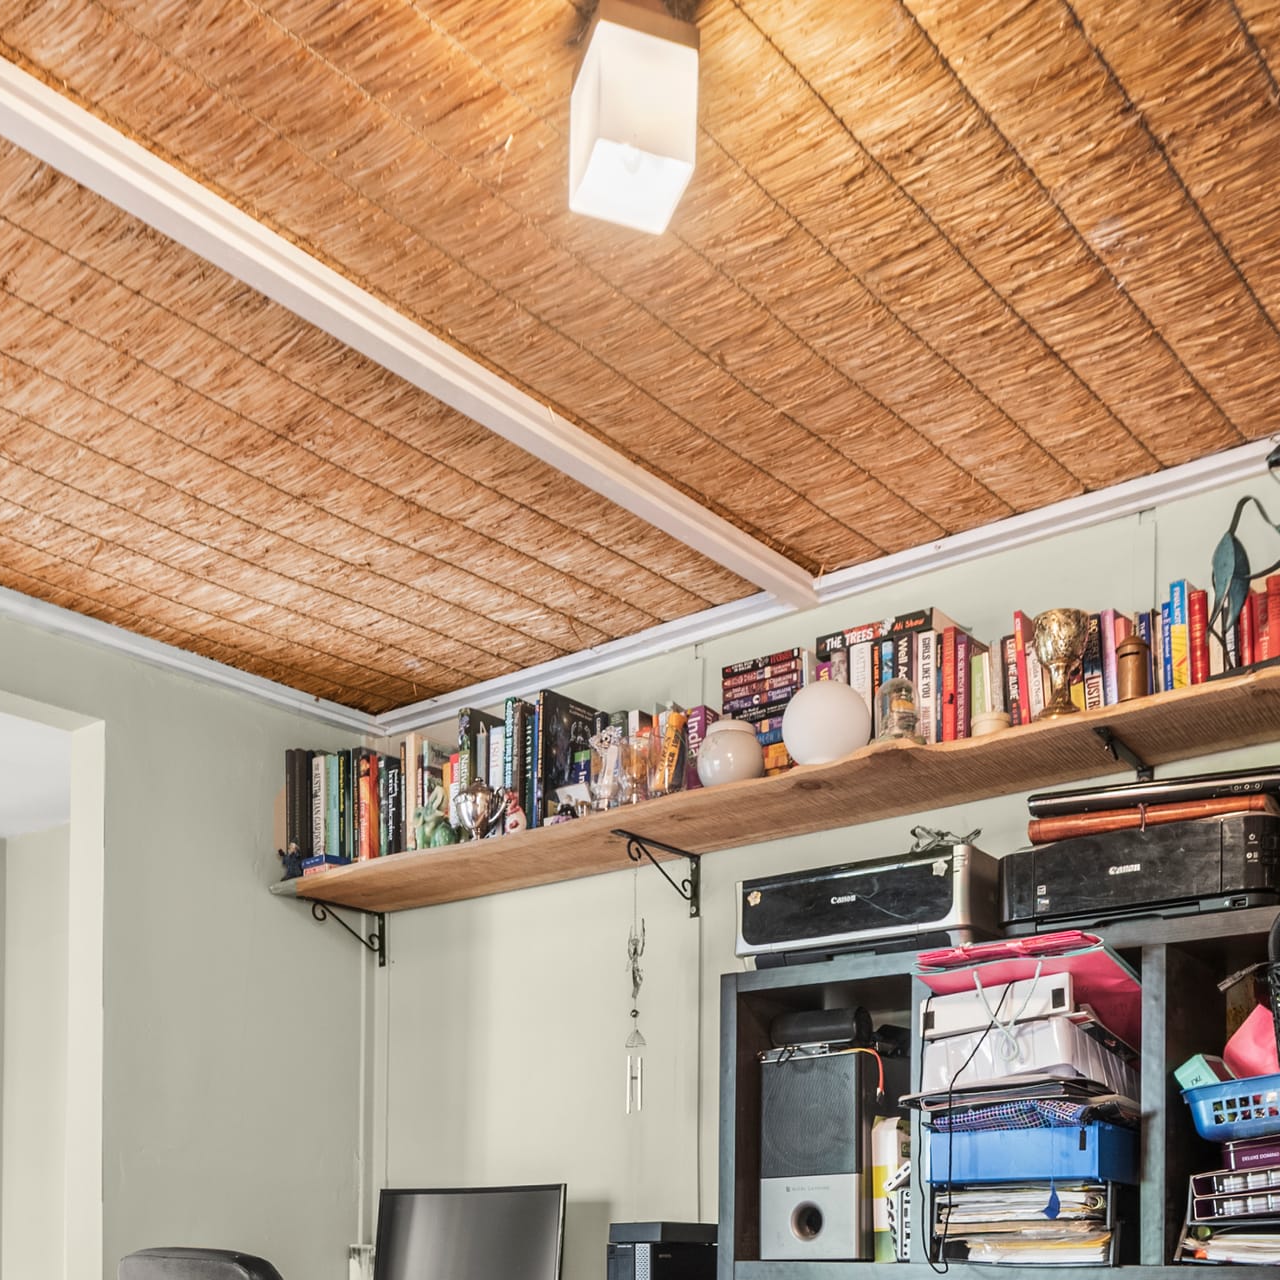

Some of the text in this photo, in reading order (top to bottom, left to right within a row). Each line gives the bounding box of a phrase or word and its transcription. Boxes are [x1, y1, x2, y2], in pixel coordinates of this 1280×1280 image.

[826, 634, 842, 651] THE
[844, 627, 874, 645] TREES
[904, 616, 926, 629] Shaw
[897, 637, 908, 664] Well
[921, 637, 931, 698] GIRLS LIKE YOU
[1006, 638, 1019, 700] LEAVE ME ALONE
[1032, 658, 1040, 679] Gilda
[1086, 675, 1101, 711] LUSTR
[687, 717, 702, 757] India
[460, 753, 469, 789] Native
[313, 772, 322, 815] AUSTRALIAN
[387, 769, 397, 841] home landscaping
[359, 799, 368, 841] free plants
[1107, 862, 1142, 876] Canon
[831, 894, 857, 905] Canon
